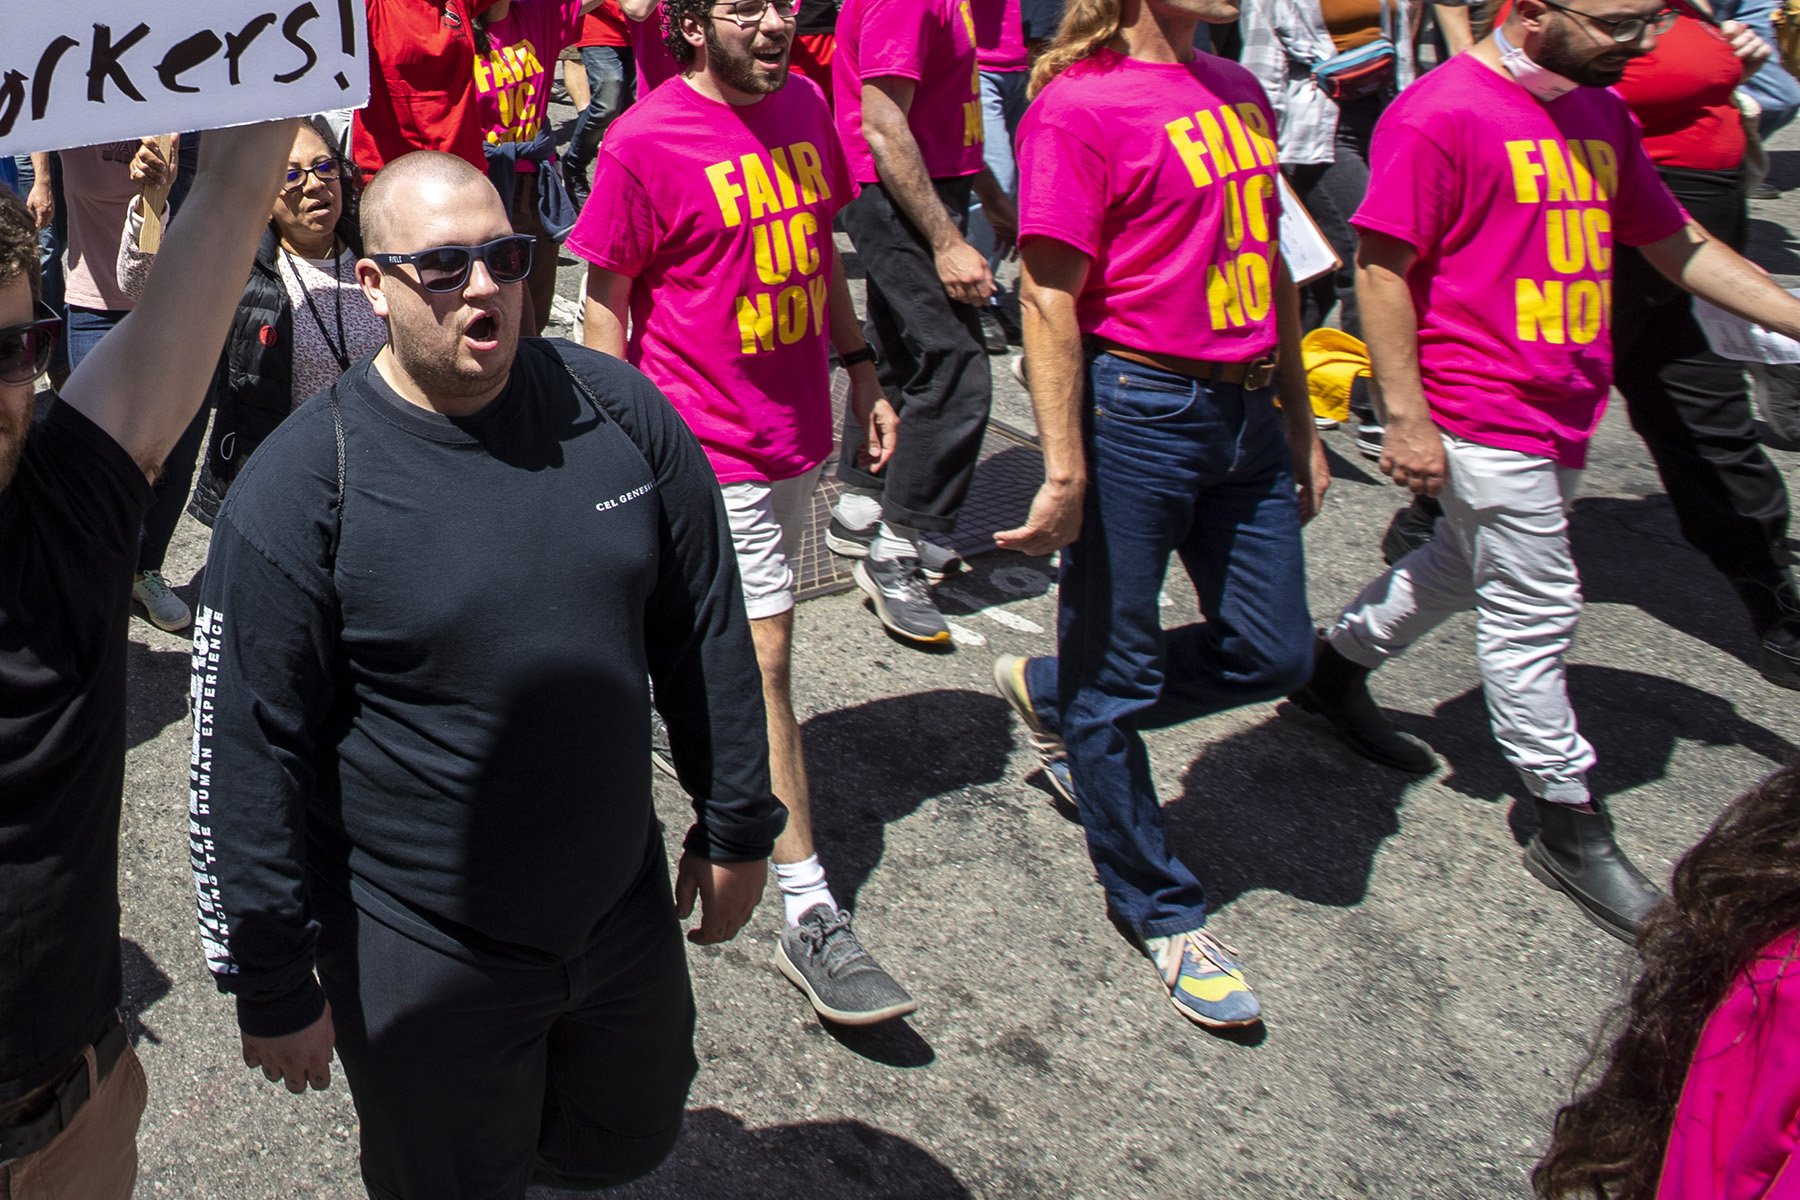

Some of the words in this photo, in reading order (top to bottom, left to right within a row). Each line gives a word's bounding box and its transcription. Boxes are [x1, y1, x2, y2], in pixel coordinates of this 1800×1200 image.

[473, 39, 545, 93] FAIR
[497, 81, 536, 128] UC
[1165, 102, 1279, 188] FAIR
[1505, 139, 1619, 203] FAIR
[704, 141, 832, 228] FAIR
[1223, 174, 1274, 251] UC
[752, 211, 820, 286] UC
[1546, 207, 1612, 274] UC
[1206, 240, 1280, 331] NO
[596, 499, 619, 512] CEL
[201, 610, 225, 738] EXPERIENCE
[198, 746, 214, 815] HUMAN
[199, 826, 217, 865] THE
